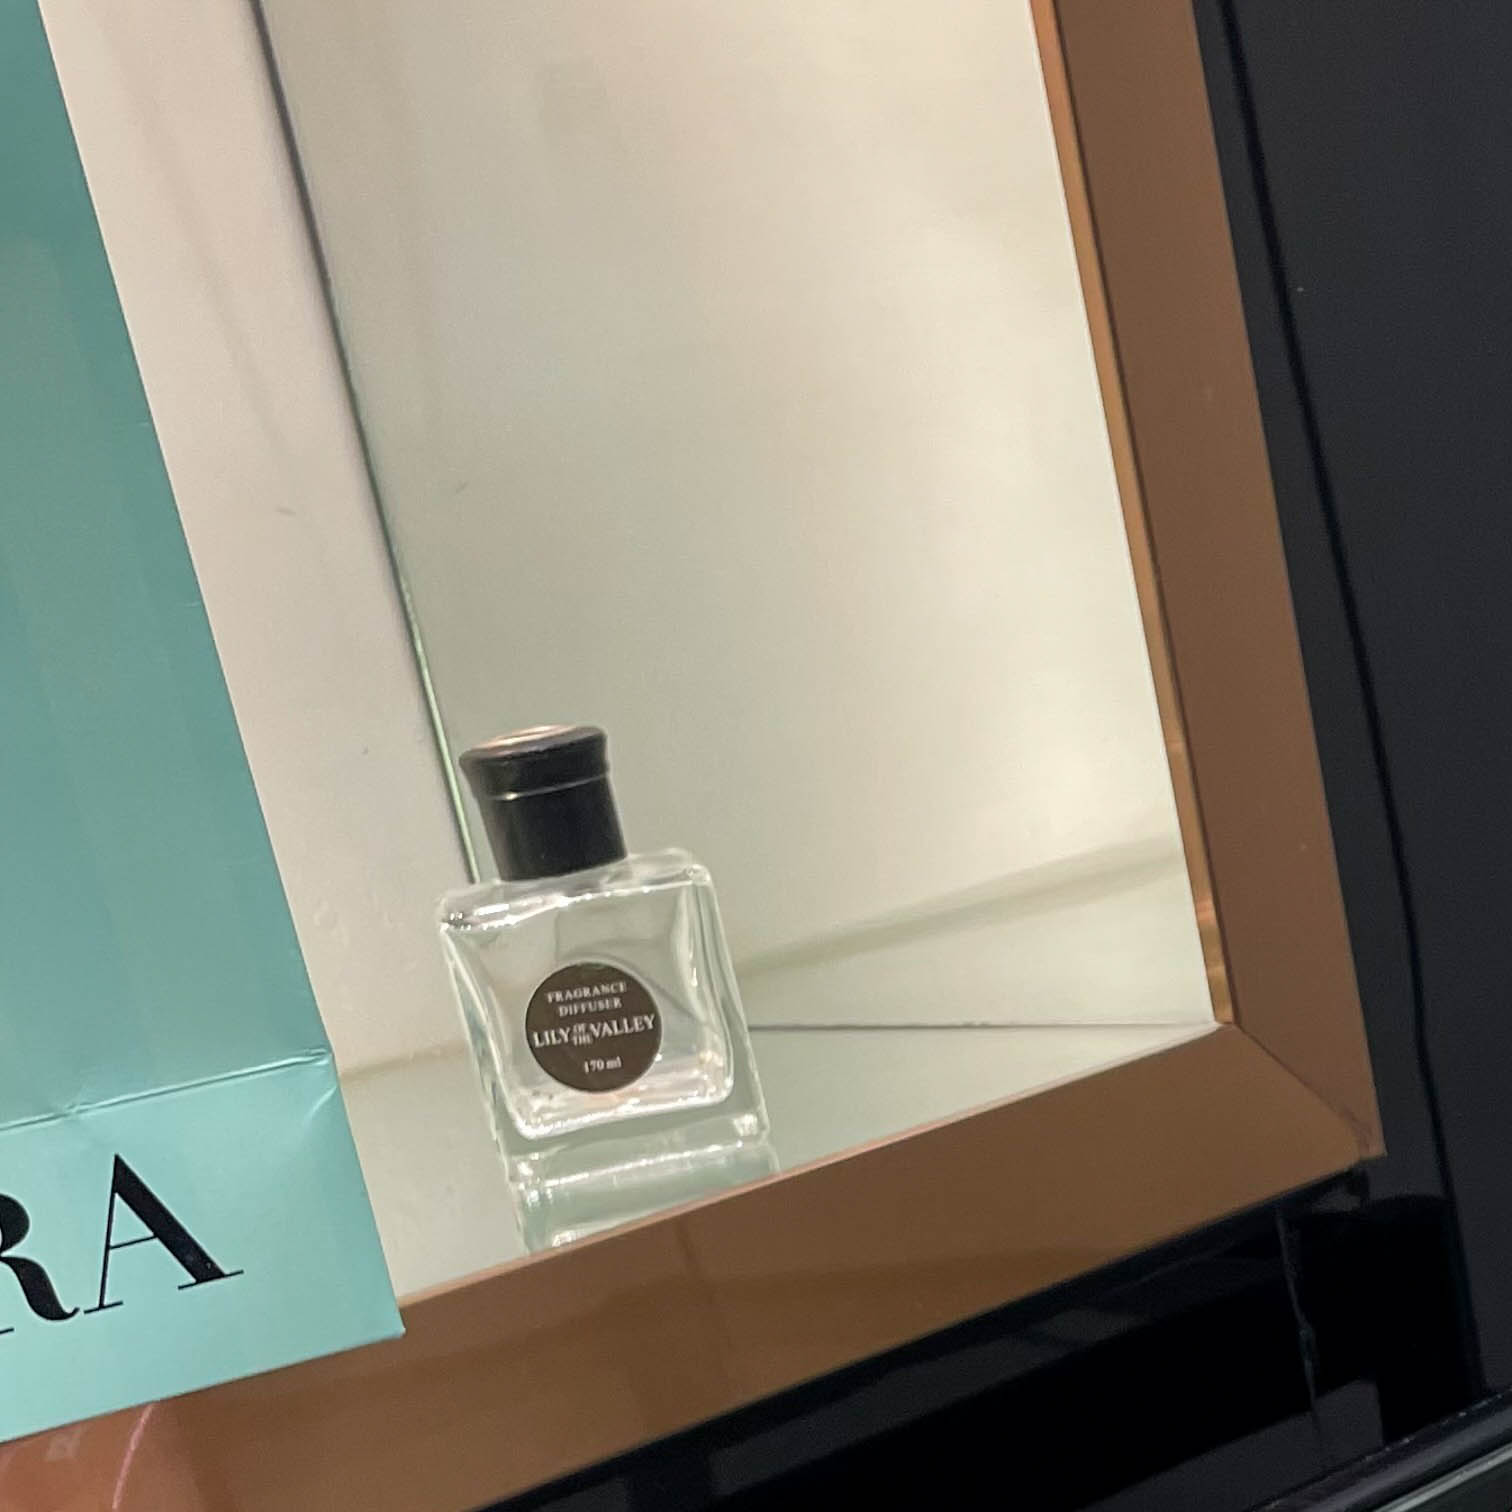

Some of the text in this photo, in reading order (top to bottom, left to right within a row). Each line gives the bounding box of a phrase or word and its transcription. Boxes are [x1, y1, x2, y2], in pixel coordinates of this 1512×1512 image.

[547, 982, 627, 1003] FRAGRANCE
[559, 997, 622, 1017] DIFFUSER
[533, 1027, 571, 1048] LILY
[590, 1014, 656, 1039] VALLEY
[584, 1056, 622, 1073] 170 ml
